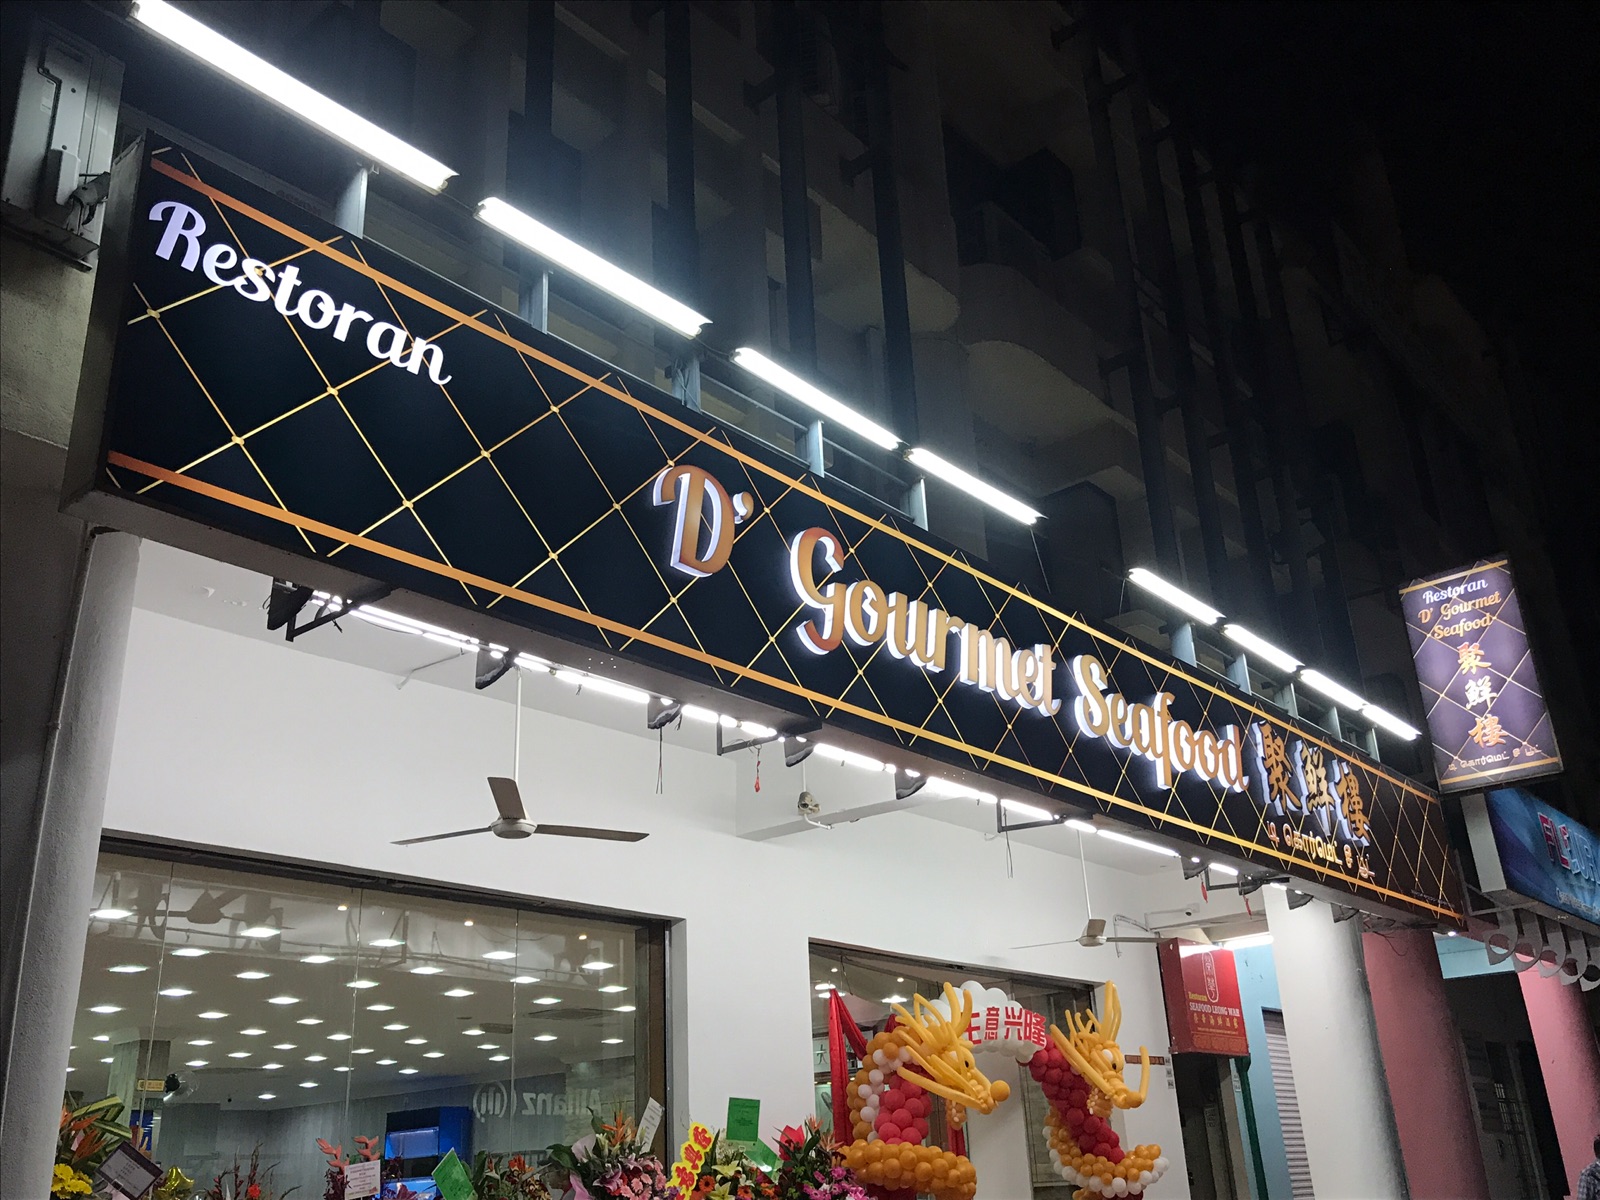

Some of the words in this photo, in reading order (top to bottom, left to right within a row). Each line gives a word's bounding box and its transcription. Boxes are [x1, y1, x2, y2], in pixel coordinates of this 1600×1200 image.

[149, 201, 452, 385] Restoran
[1422, 579, 1489, 604] Restoran
[1441, 591, 1502, 621] Gourmet
[1433, 612, 1493, 640] Seafood
[790, 527, 1061, 717] Gourmet
[1073, 654, 1249, 793] Seafood
